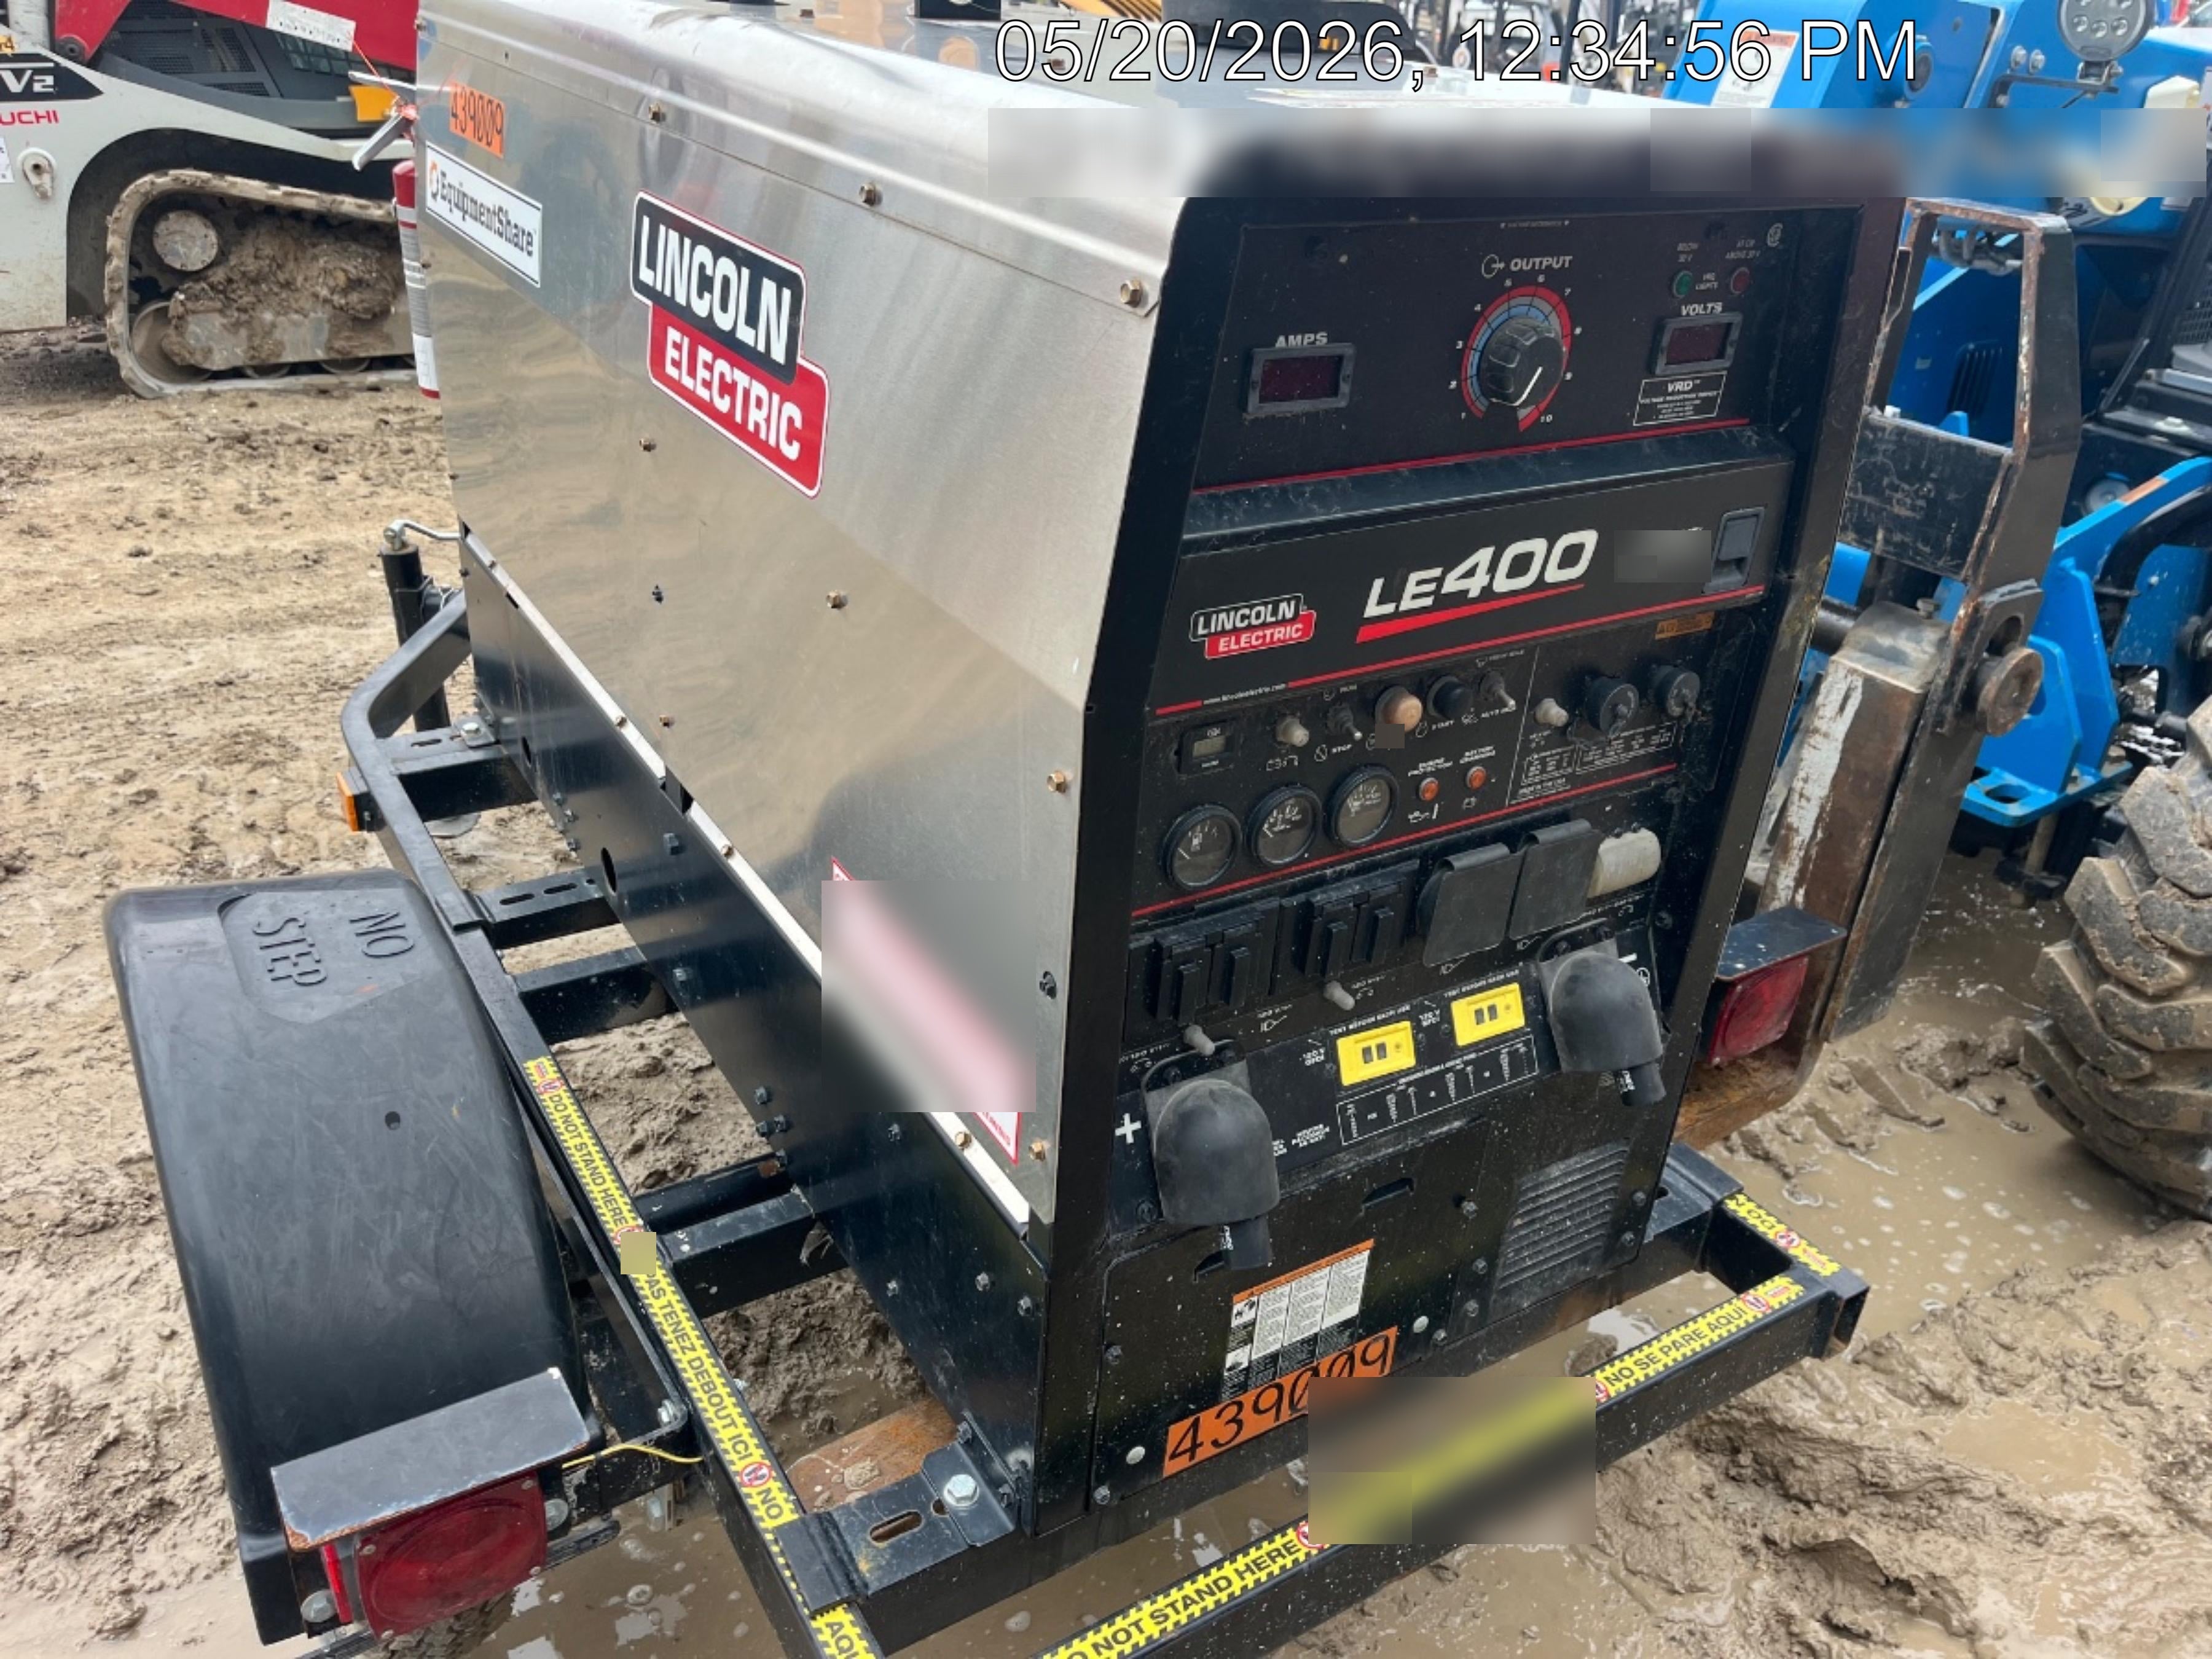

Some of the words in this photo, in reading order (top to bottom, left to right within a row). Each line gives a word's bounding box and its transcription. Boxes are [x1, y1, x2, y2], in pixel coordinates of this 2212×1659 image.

[452, 85, 504, 154] 439009
[440, 170, 533, 257] EquipmentShare
[638, 215, 792, 366] LINCOLN
[1510, 255, 1573, 272] OUTPUT
[1275, 332, 1328, 348] AMPS
[1681, 302, 1723, 316] VOLTS
[665, 326, 803, 461] ELECTRIC
[1363, 529, 1598, 618] LE400
[1197, 599, 1296, 635] LINCOLN
[1218, 623, 1304, 653] ELECTRIC
[252, 917, 328, 987] STEP
[349, 912, 415, 959] NO
[548, 1093, 566, 1113] DO
[559, 1112, 581, 1140] NOT
[575, 1142, 605, 1186] STAND
[598, 1188, 629, 1228] HERE
[645, 1274, 667, 1300] AS
[658, 1300, 697, 1355] TENEZ
[685, 1357, 737, 1437] DEBOUT
[727, 1435, 754, 1461] ICI
[1605, 1359, 1634, 1387] NO
[1631, 1346, 1658, 1371] SE
[1658, 1329, 1706, 1357] PARE
[1708, 1306, 1749, 1336] AQUI
[756, 1487, 784, 1521] NO
[1090, 1618, 1145, 1657] NOT
[1153, 1574, 1234, 1625] STAND
[1236, 1541, 1301, 1582] HERE
